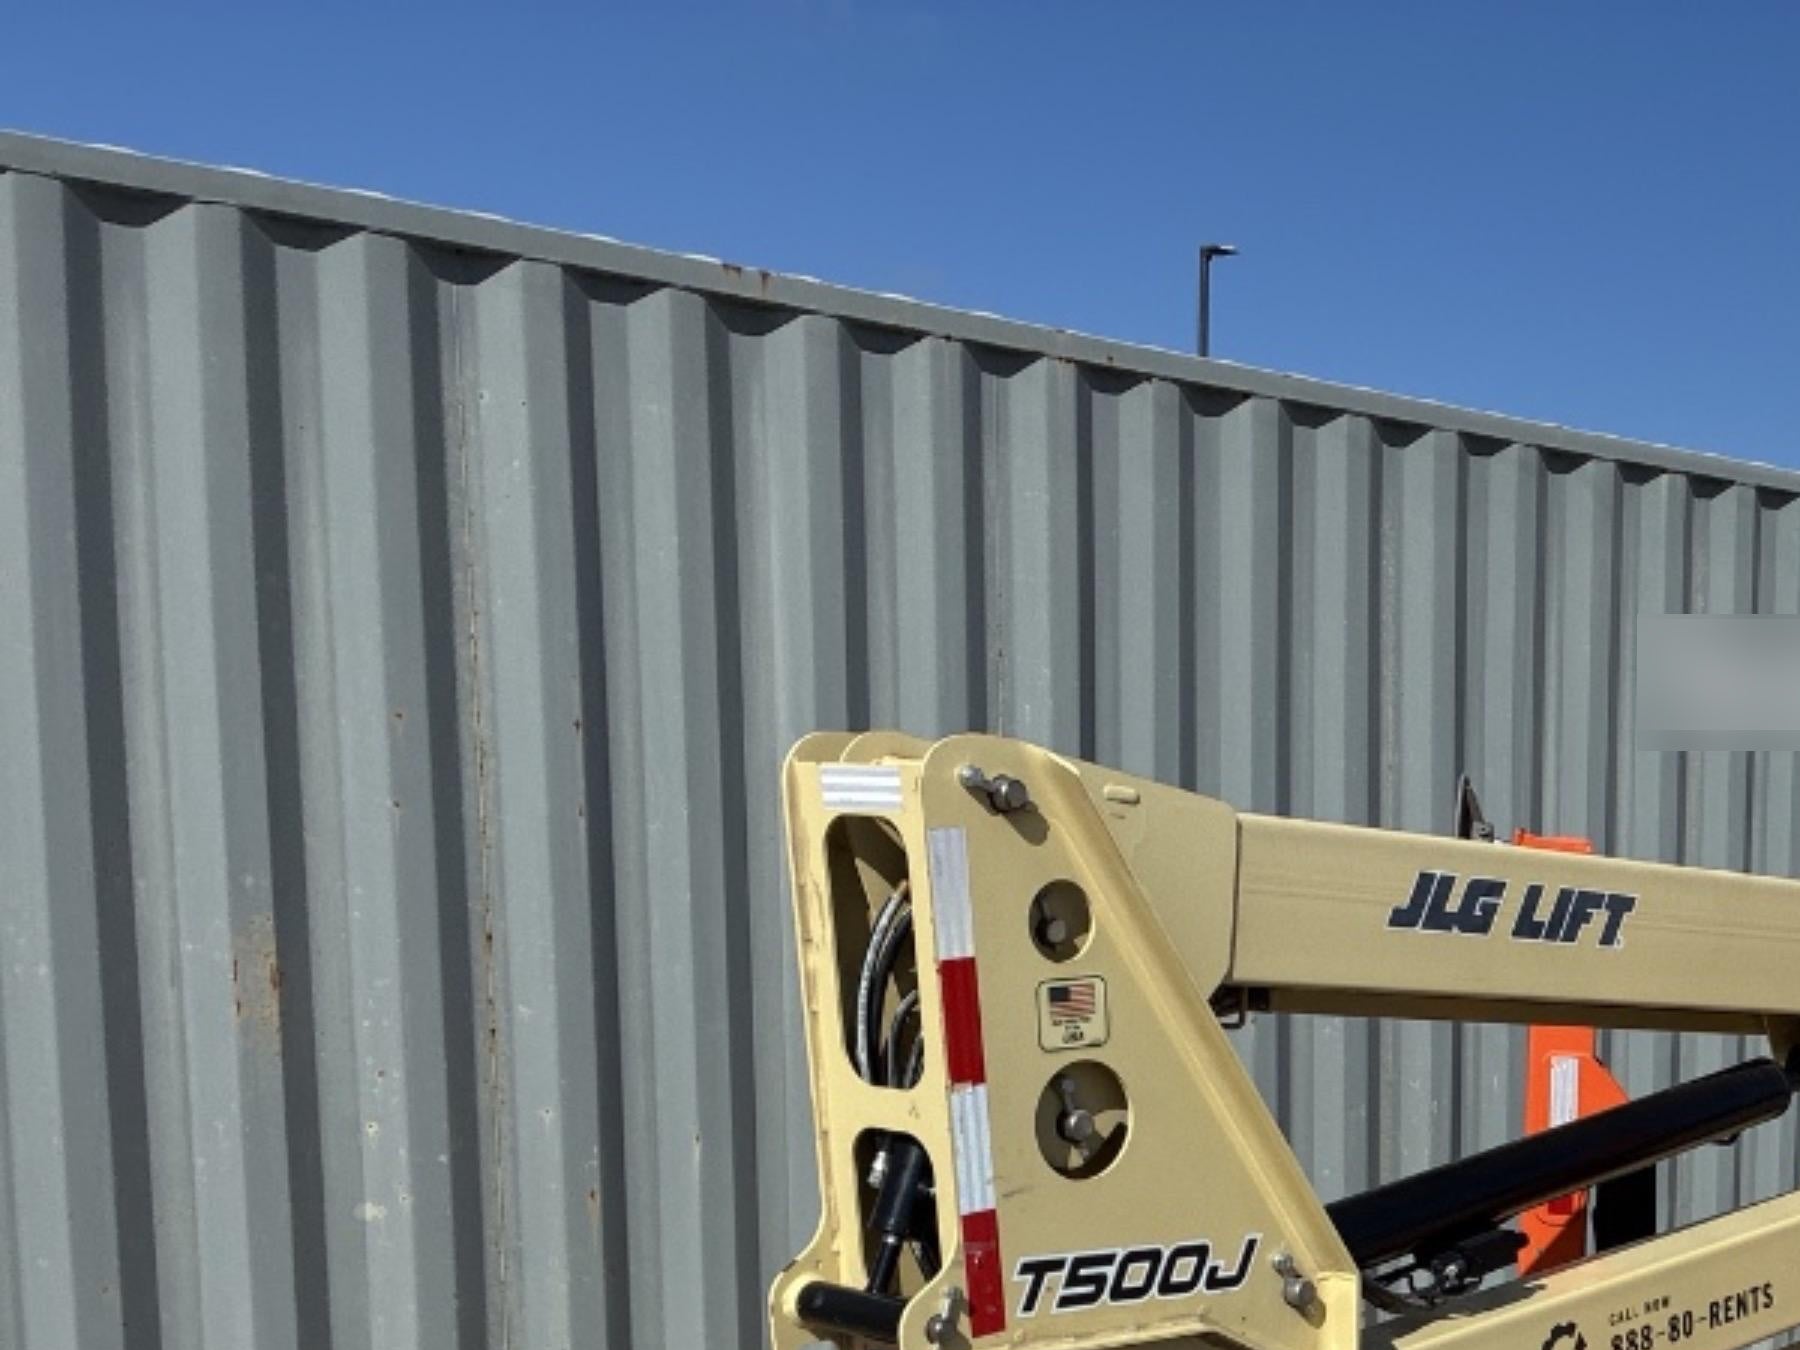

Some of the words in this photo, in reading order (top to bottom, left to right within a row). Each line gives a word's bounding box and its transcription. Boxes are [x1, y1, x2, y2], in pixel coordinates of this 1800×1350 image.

[1386, 871, 1508, 936] JLG
[1510, 883, 1638, 948] LIFT
[1014, 1235, 1261, 1316] T500J
